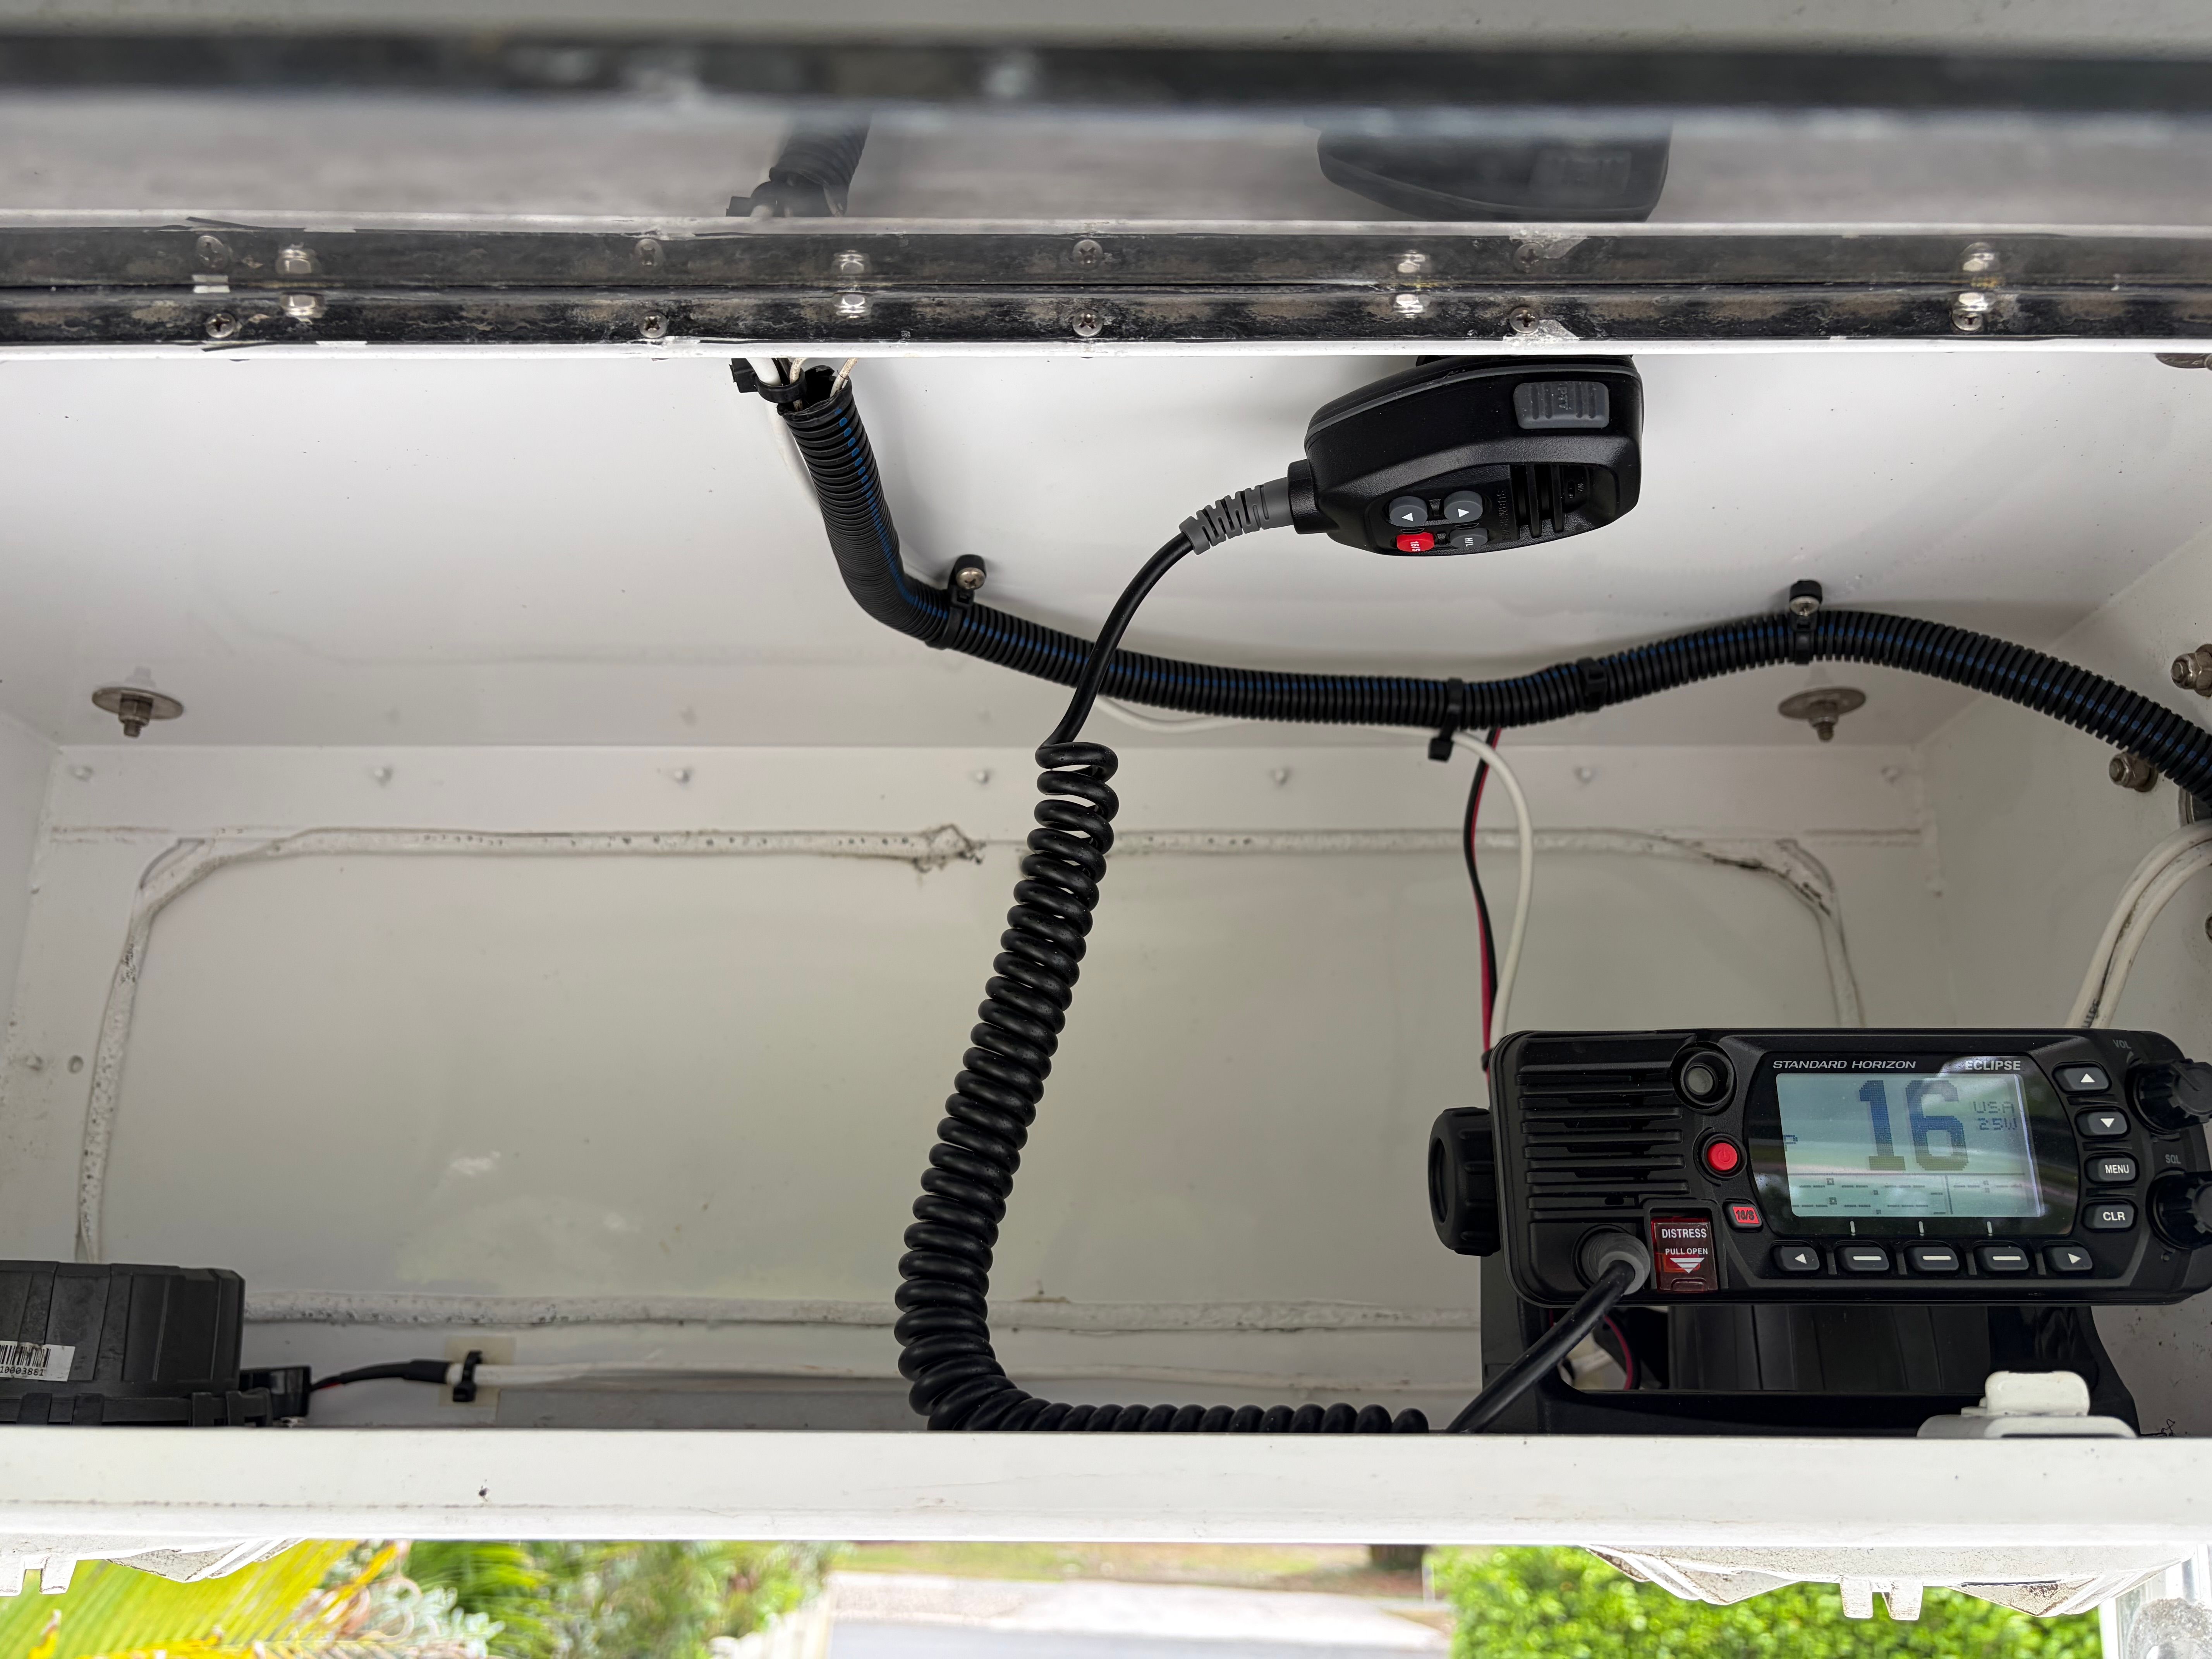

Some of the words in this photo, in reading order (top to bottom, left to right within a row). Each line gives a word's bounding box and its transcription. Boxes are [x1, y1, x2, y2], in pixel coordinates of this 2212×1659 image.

[1410, 541, 1421, 551] 16/S
[1465, 538, 1474, 547] H/L
[2112, 1039, 2131, 1049] VOL
[1965, 1060, 2021, 1070] ECLIPSE
[1973, 1101, 2014, 1114] USA
[1859, 1080, 1969, 1171] 16
[1978, 1118, 2018, 1130] 25W
[2165, 1154, 2181, 1164] SQL
[2105, 1164, 2130, 1174] MENU
[2103, 1211, 2126, 1221] CLR
[1662, 1228, 1707, 1238] DISTRESS
